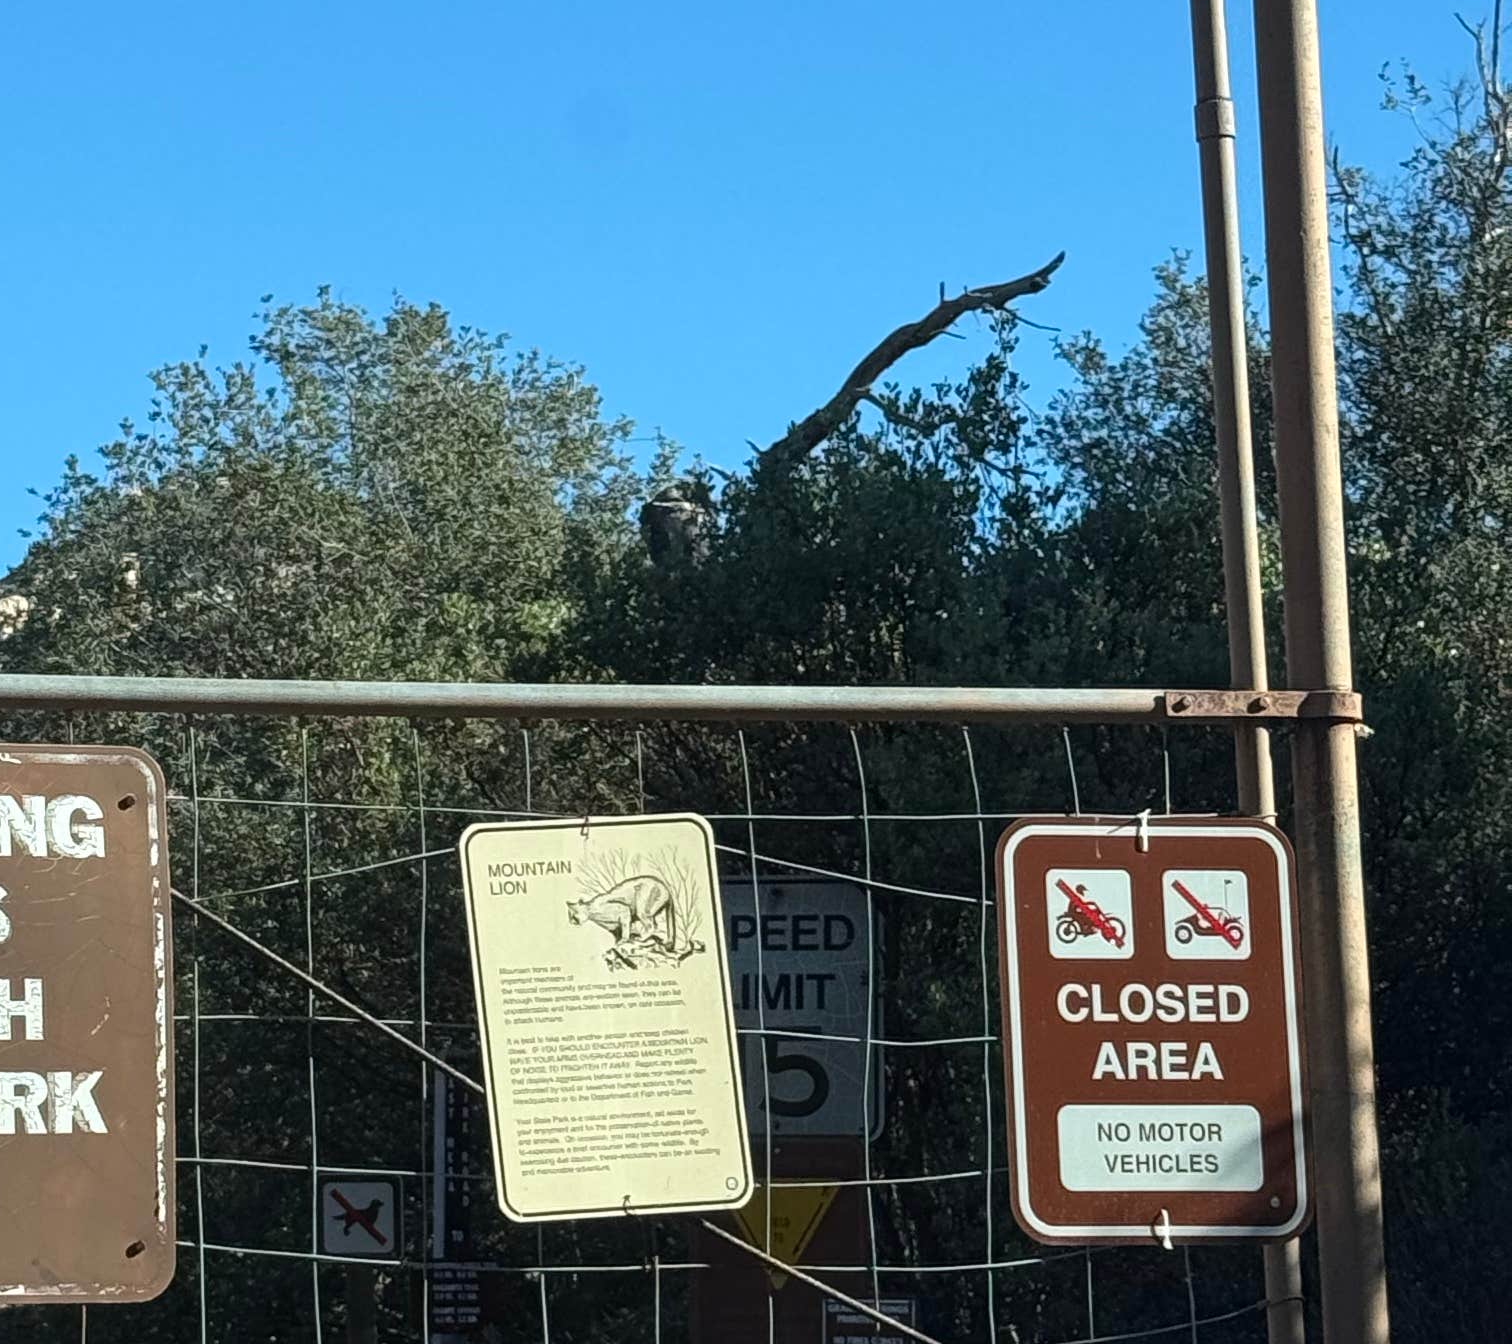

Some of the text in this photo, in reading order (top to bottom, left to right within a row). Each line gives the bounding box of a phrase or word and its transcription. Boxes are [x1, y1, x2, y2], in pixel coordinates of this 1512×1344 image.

[488, 860, 572, 877] MOUNTAIN
[490, 880, 527, 896] LION
[730, 914, 856, 952] PEED
[735, 973, 836, 1010] IMIT
[1057, 983, 1250, 1023] CLOSED
[1092, 1042, 1224, 1081] AREA
[1097, 1122, 1223, 1143] NO MOTOR
[1104, 1154, 1219, 1174] VEHICLES
